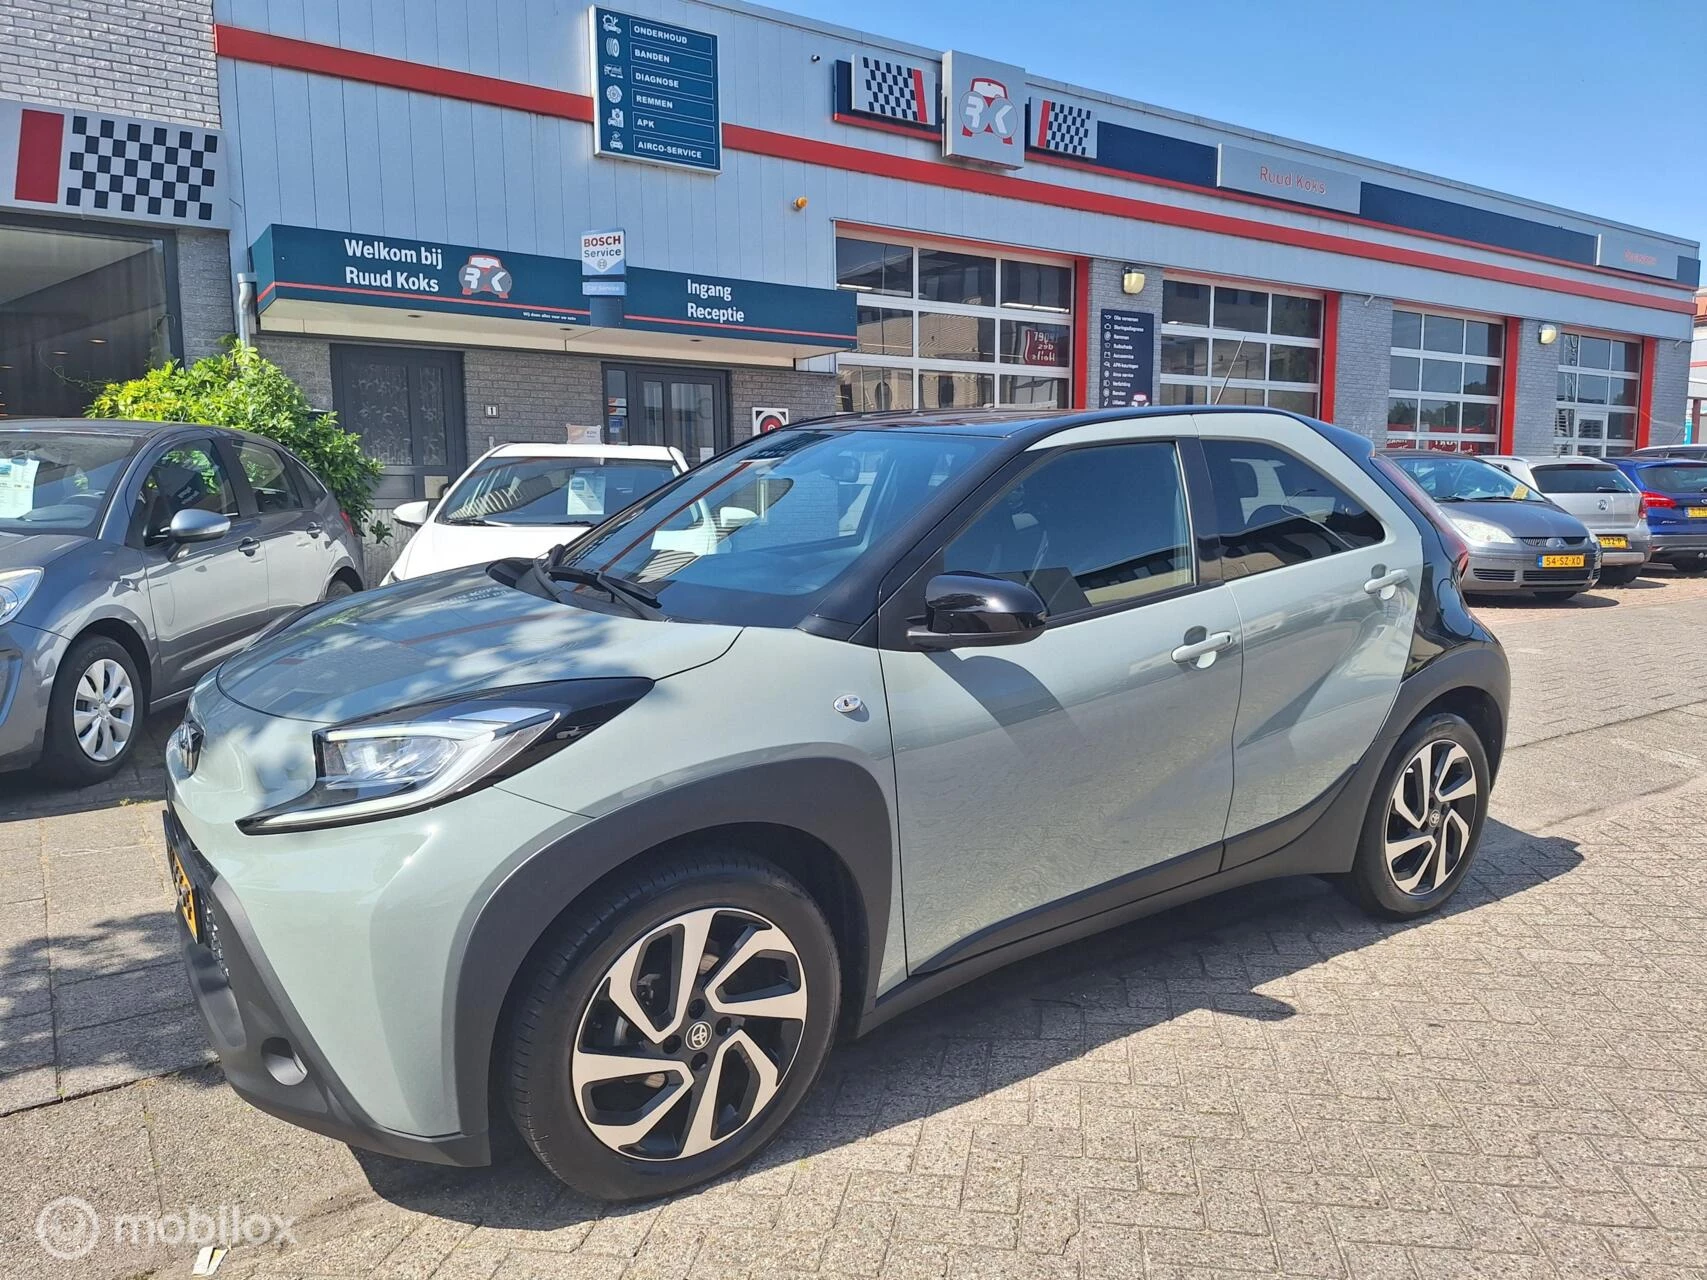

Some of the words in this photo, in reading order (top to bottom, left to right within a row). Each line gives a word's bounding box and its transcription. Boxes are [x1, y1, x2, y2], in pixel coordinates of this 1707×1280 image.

[634, 25, 688, 44] ONDERHOUD
[634, 49, 670, 63] BANDEN
[635, 72, 679, 88] DIAGNOSE
[636, 95, 673, 109] REMMEN
[637, 118, 655, 128] APK
[637, 141, 702, 159] AIRCO-SERVICE
[1260, 166, 1293, 187] Ruud
[1296, 175, 1327, 194] Koks
[583, 235, 621, 248] BOSCH
[344, 238, 417, 264] Welkom
[420, 246, 443, 270] bij
[584, 247, 622, 258] Service
[345, 266, 392, 288] Ruud
[396, 271, 440, 292] Koks
[687, 278, 732, 302] Ingang
[687, 302, 745, 323] Receptie
